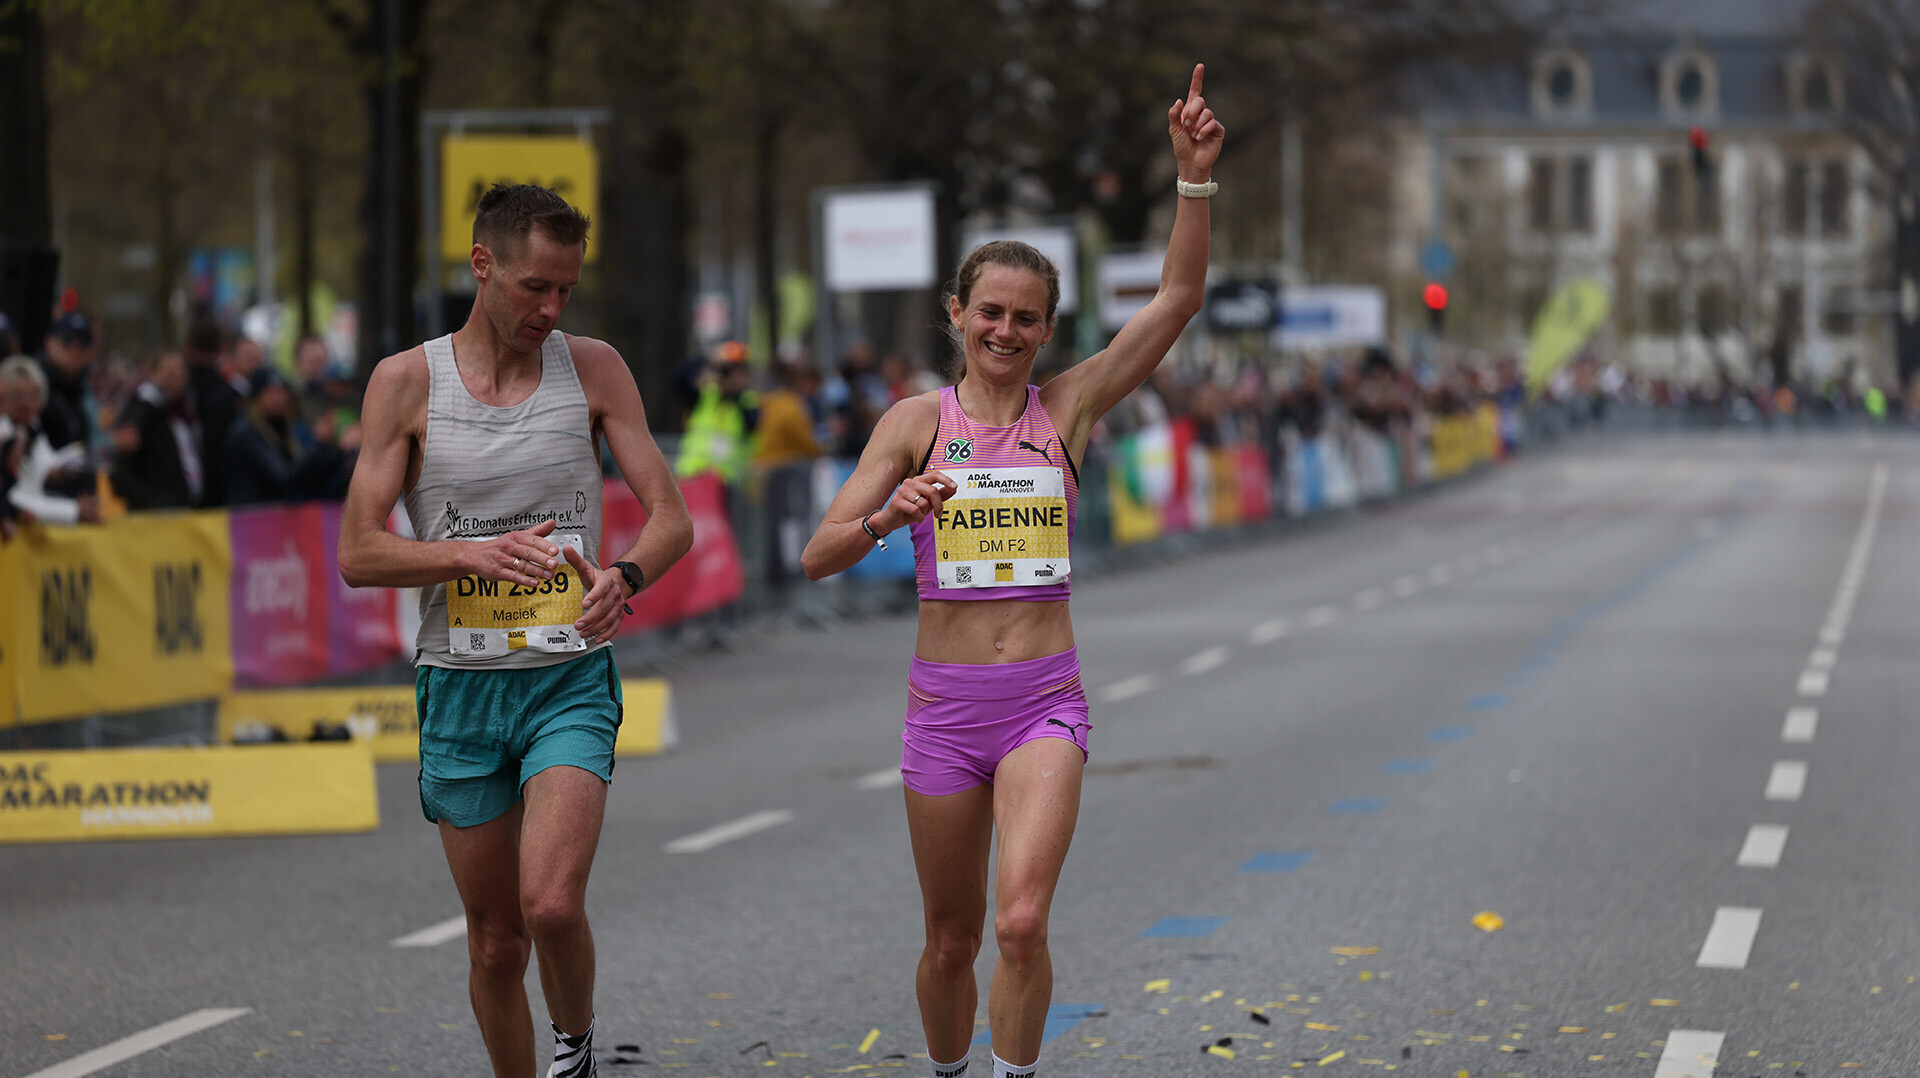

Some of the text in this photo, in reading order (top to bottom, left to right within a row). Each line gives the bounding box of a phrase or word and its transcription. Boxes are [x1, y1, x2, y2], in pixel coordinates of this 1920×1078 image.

[946, 441, 972, 460] 96
[967, 473, 991, 481] ADAC
[978, 480, 1034, 488] MARATHON
[473, 517, 513, 529] Donatus
[514, 511, 556, 525] Erftstadt
[559, 511, 572, 522] e.V.
[939, 507, 1063, 530] FABIENNE
[980, 539, 1026, 552] DM F2
[457, 576, 498, 597] DM
[493, 608, 538, 621] Maciek
[454, 617, 463, 626] A
[508, 631, 526, 639] ADAC
[0, 781, 211, 811] MARATHON
